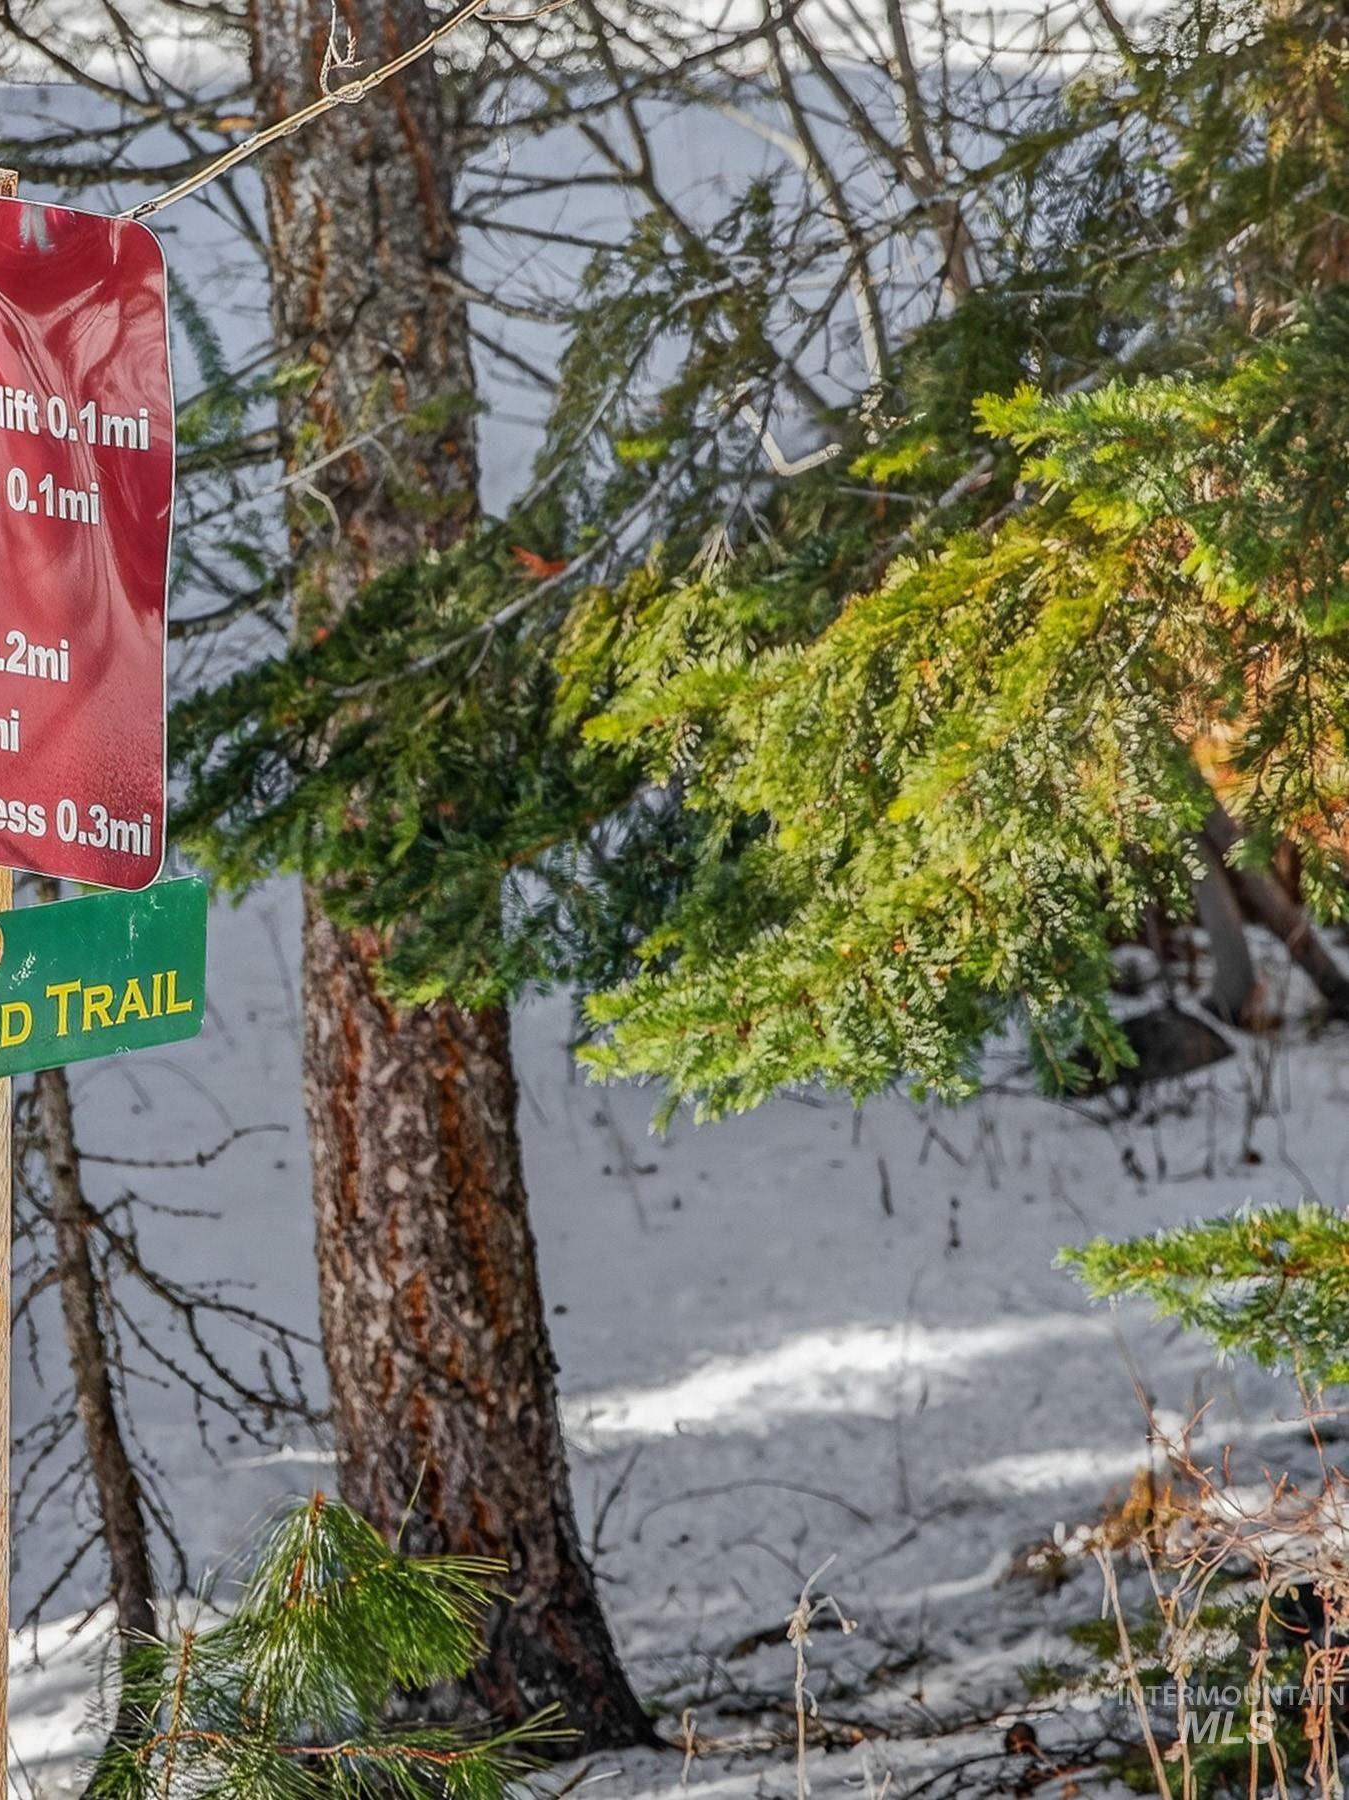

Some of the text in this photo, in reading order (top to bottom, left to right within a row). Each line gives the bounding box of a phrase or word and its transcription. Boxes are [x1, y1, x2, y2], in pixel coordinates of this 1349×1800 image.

[47, 396, 150, 452] 0.1mi
[7, 467, 100, 526] 0.1mi
[56, 799, 151, 857] 0.3mi
[46, 970, 194, 1037] TRAIL
